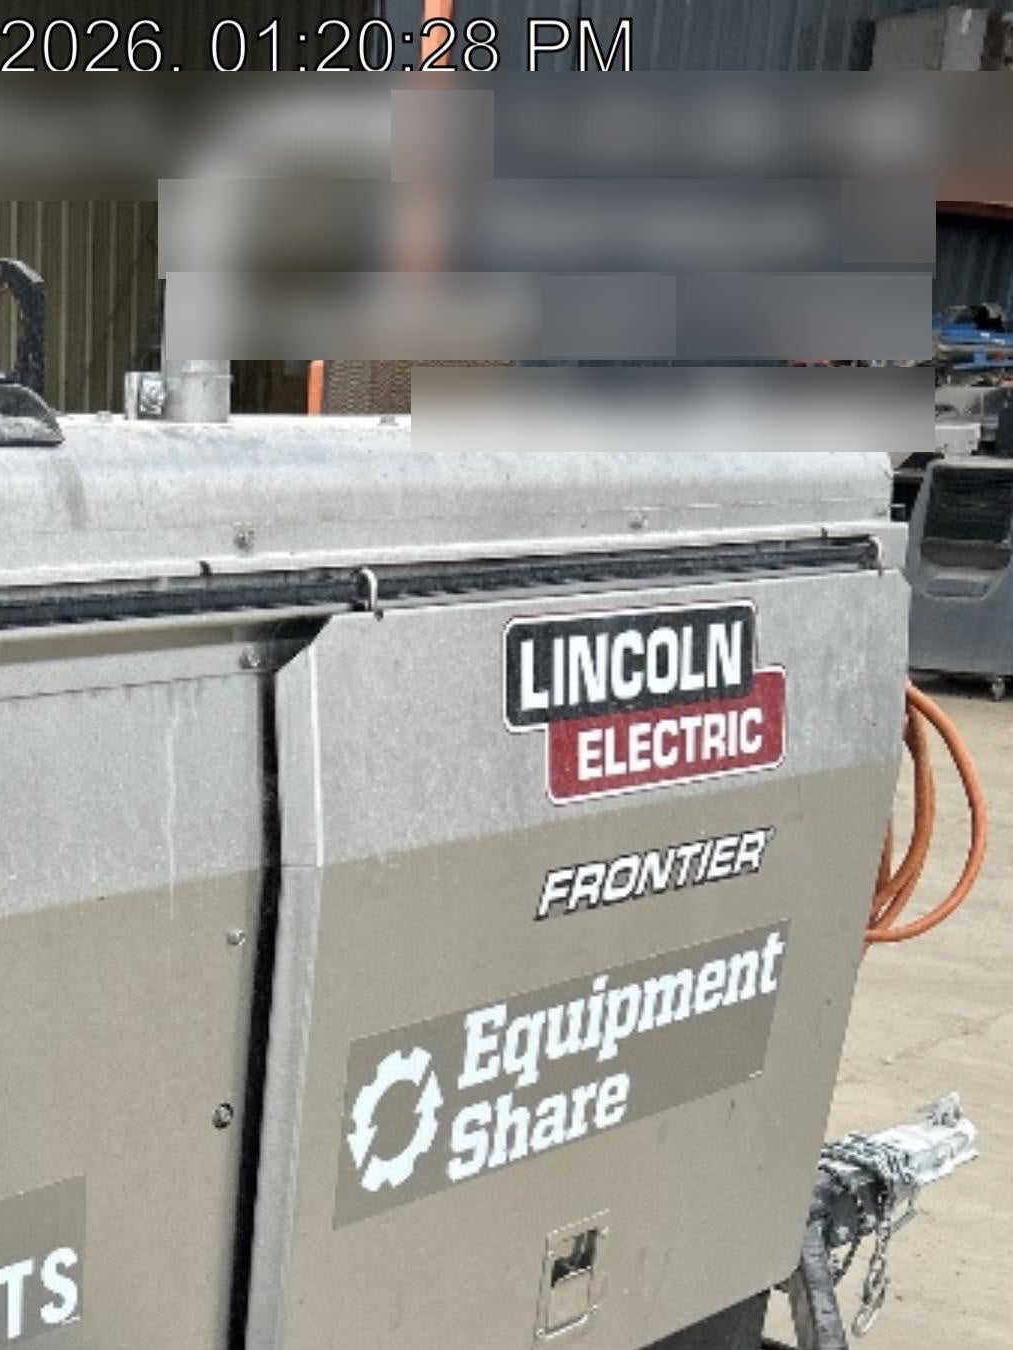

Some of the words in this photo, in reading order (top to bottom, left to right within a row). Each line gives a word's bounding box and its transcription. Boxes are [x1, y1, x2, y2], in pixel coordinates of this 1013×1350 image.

[520, 620, 743, 712] LINCOLN
[577, 707, 763, 781] ELECTRIC
[534, 827, 769, 920] FRONTIER
[457, 932, 785, 1090] Equipment
[447, 1073, 630, 1182] Share
